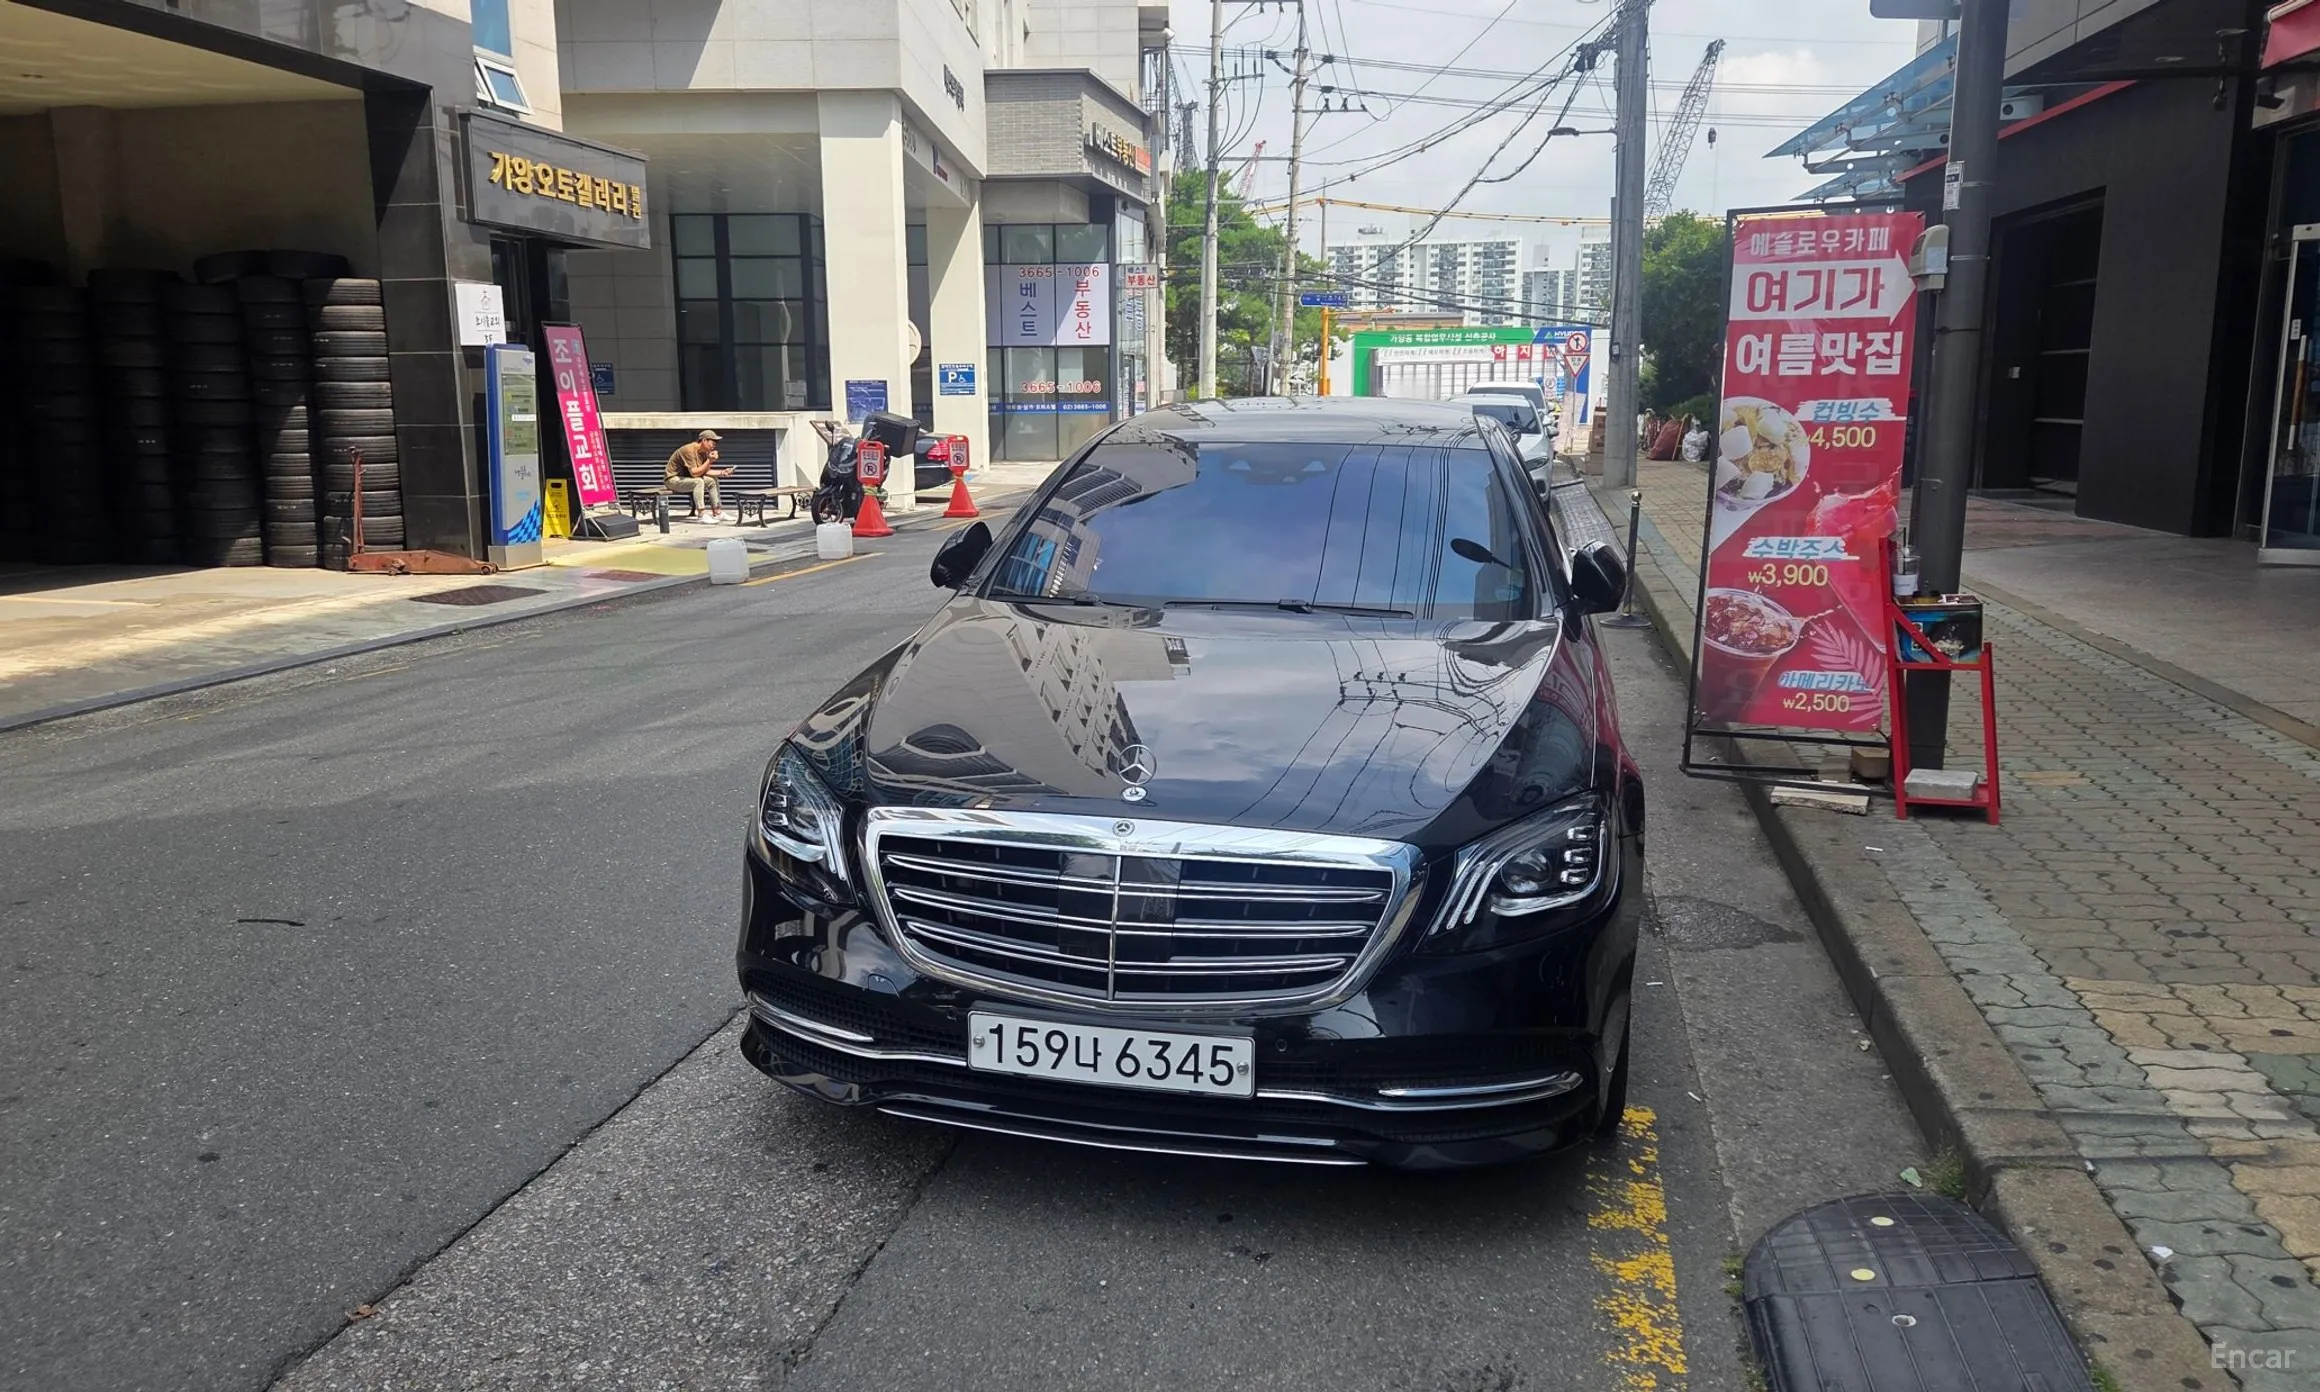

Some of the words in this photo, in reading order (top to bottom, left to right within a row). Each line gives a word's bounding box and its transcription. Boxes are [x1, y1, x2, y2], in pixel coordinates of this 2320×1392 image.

[1019, 267, 1100, 278] 3665-1006
[1127, 276, 1156, 286] 부동산
[1747, 267, 1885, 312] 여기가
[1020, 282, 1037, 337] 베스트
[1075, 279, 1092, 339] 부동산
[1736, 331, 1904, 375] 여름맛집
[1021, 381, 1101, 393] 3665-1006
[553, 339, 599, 492] 조이풀교회
[1812, 401, 1880, 423] 컵빙수
[1751, 538, 1845, 560] 수박주스
[1748, 563, 1828, 588] ₩3,900
[1780, 672, 1872, 694] 아메리카노
[1783, 692, 1850, 712] ₩2,500
[989, 1023, 1102, 1072] 159나
[1115, 1037, 1235, 1086] 6345
